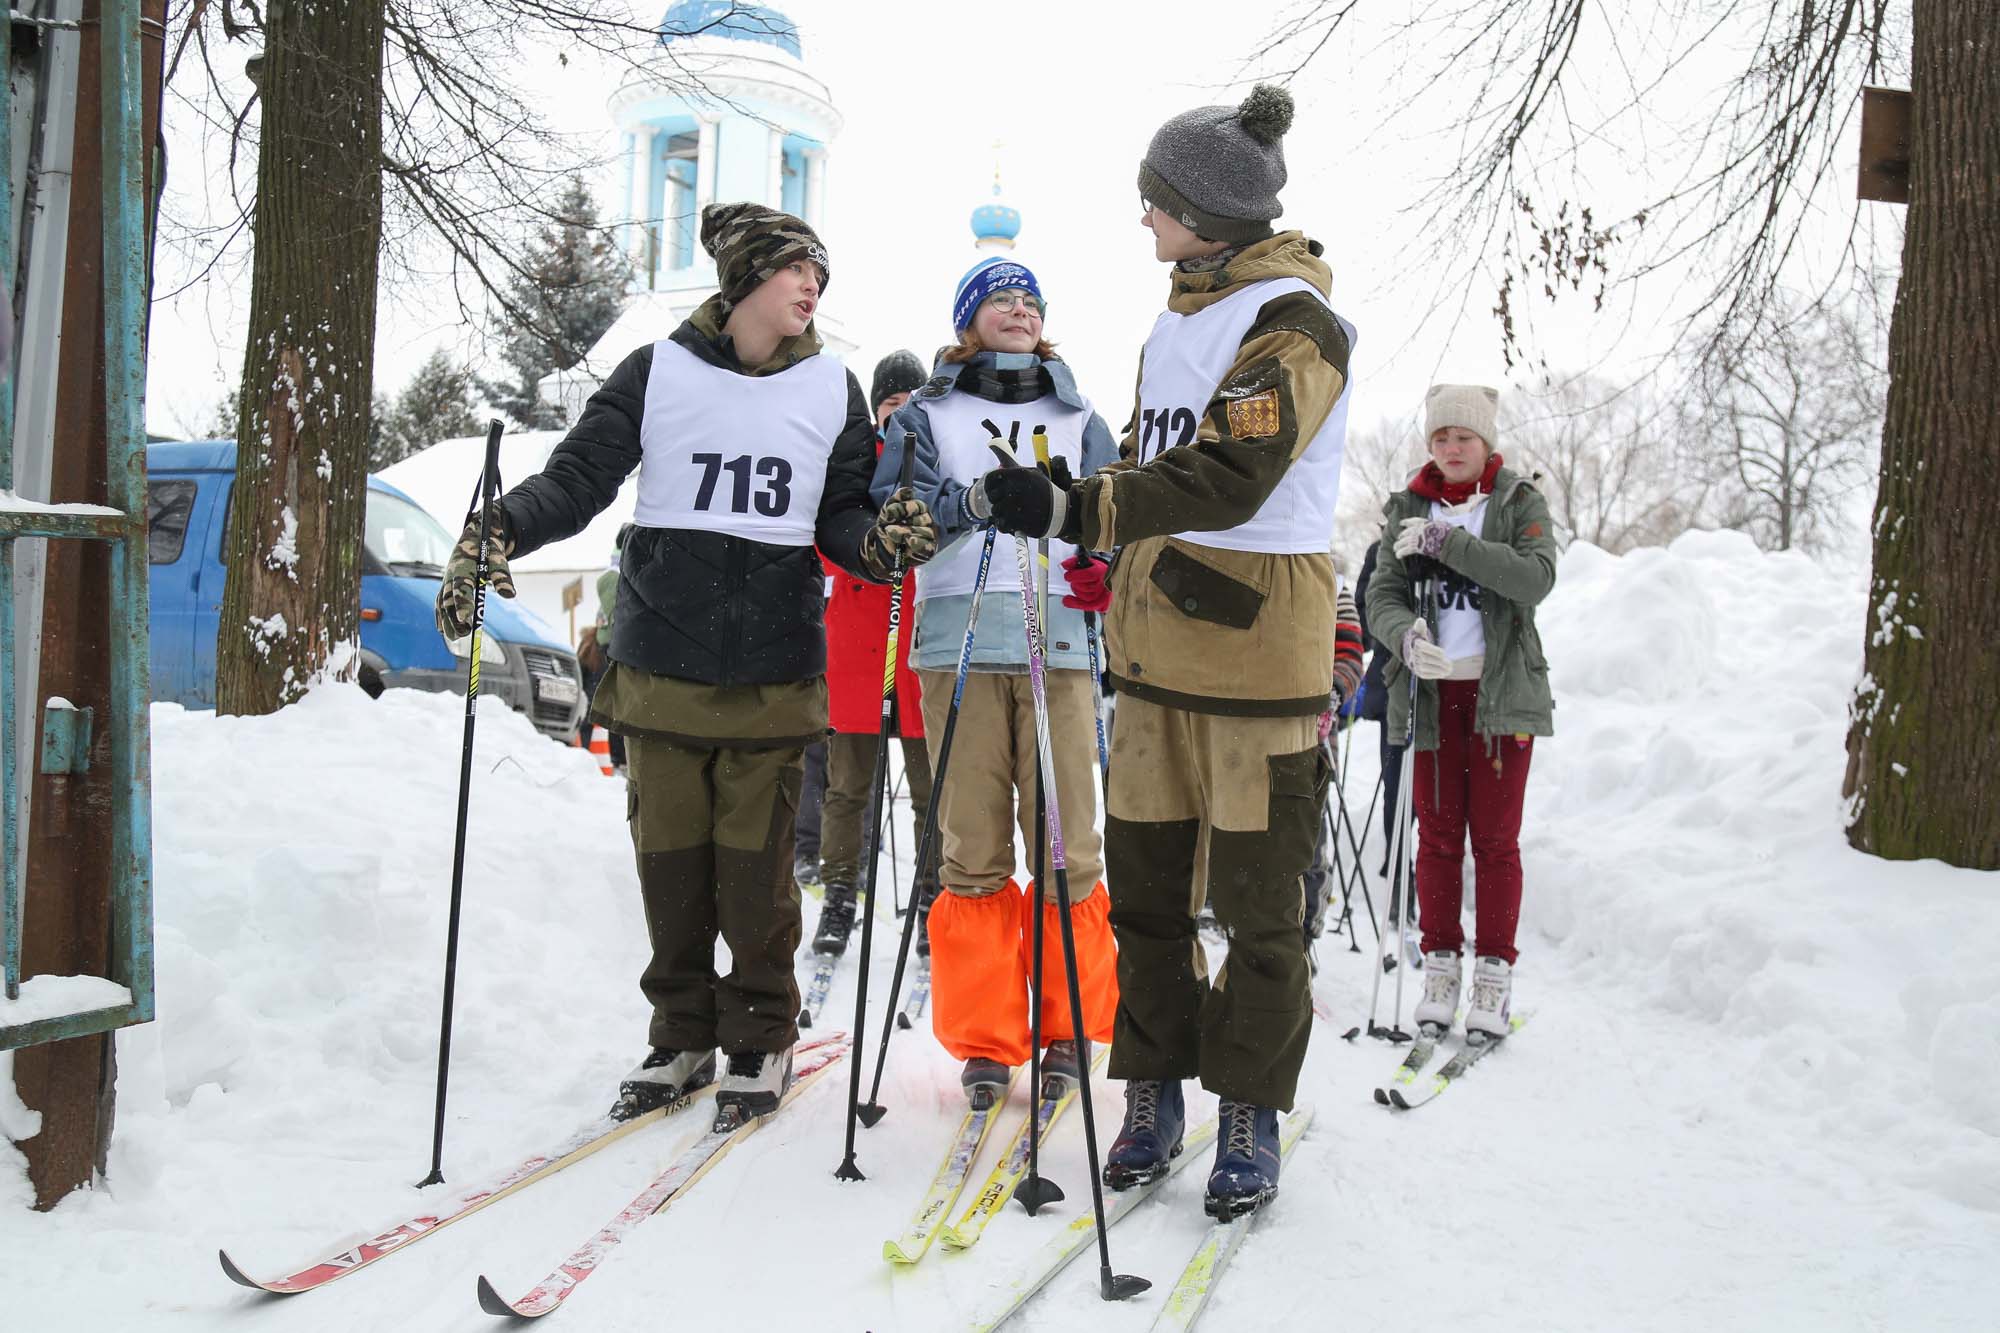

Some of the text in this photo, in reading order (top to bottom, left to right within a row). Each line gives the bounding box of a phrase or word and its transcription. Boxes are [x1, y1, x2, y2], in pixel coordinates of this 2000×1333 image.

[1139, 407, 1197, 466] 712
[691, 453, 793, 518] 713
[664, 1095, 691, 1116] TISA
[321, 1217, 438, 1268] ISA
